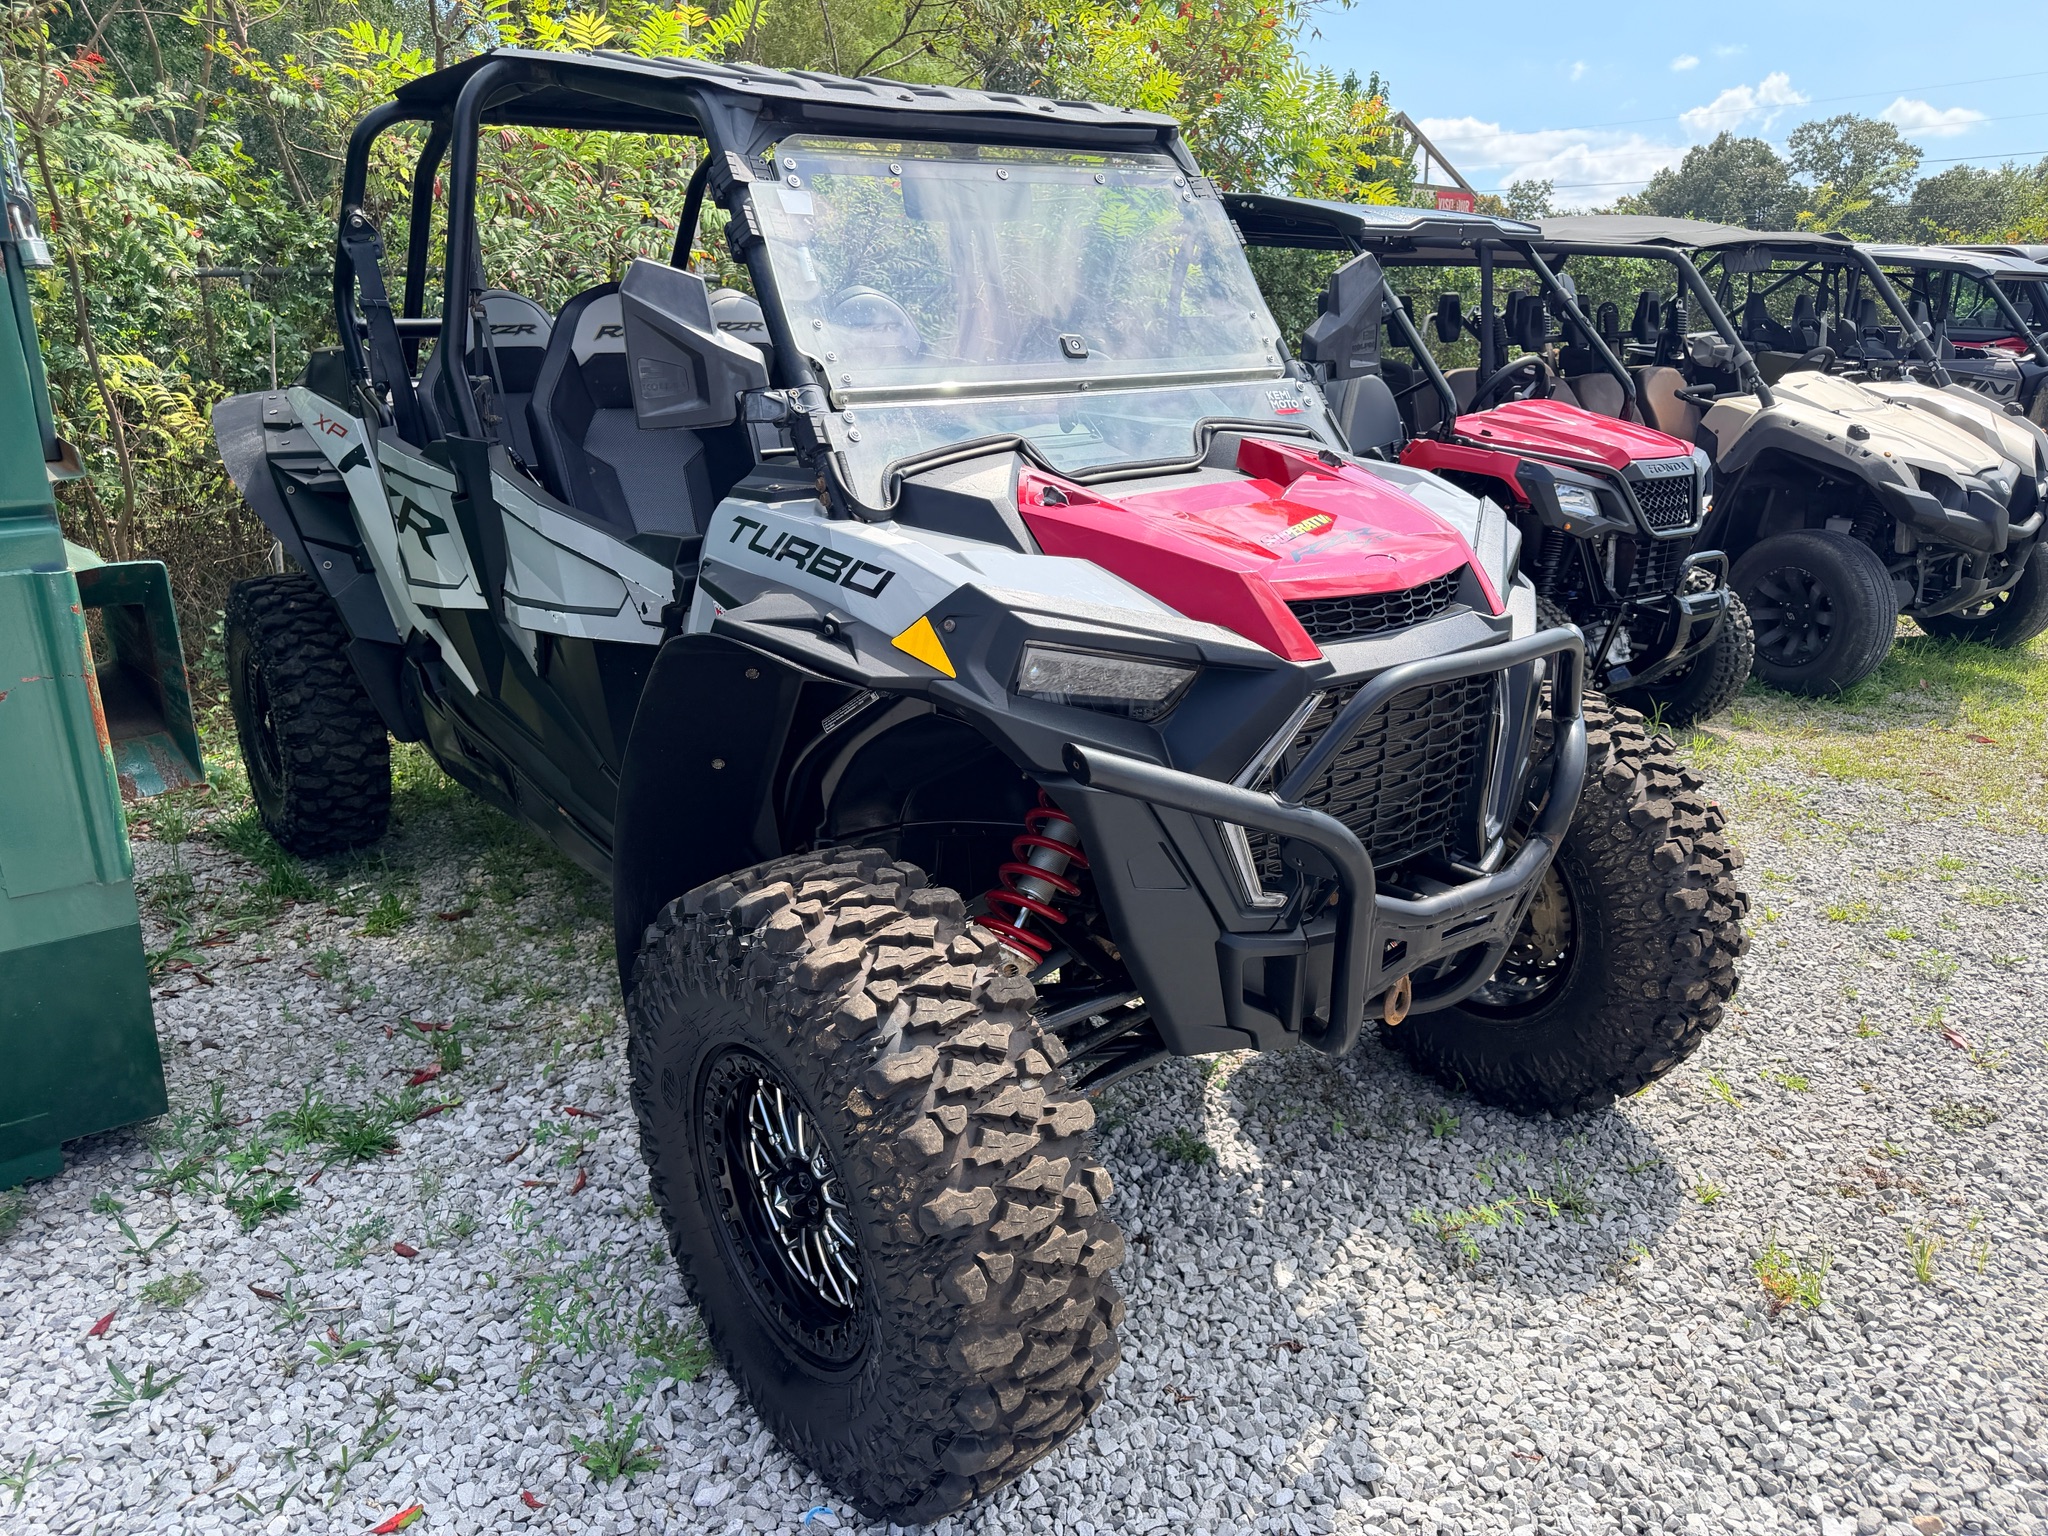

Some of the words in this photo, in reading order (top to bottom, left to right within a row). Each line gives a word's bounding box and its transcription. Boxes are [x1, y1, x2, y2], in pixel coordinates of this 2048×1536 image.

[717, 321, 764, 332] RZR
[1265, 389, 1291, 400] KEMI
[1270, 400, 1299, 409] MOTO
[313, 413, 349, 438] XP
[1646, 461, 1690, 474] HONDA
[729, 515, 896, 599] TURBO
